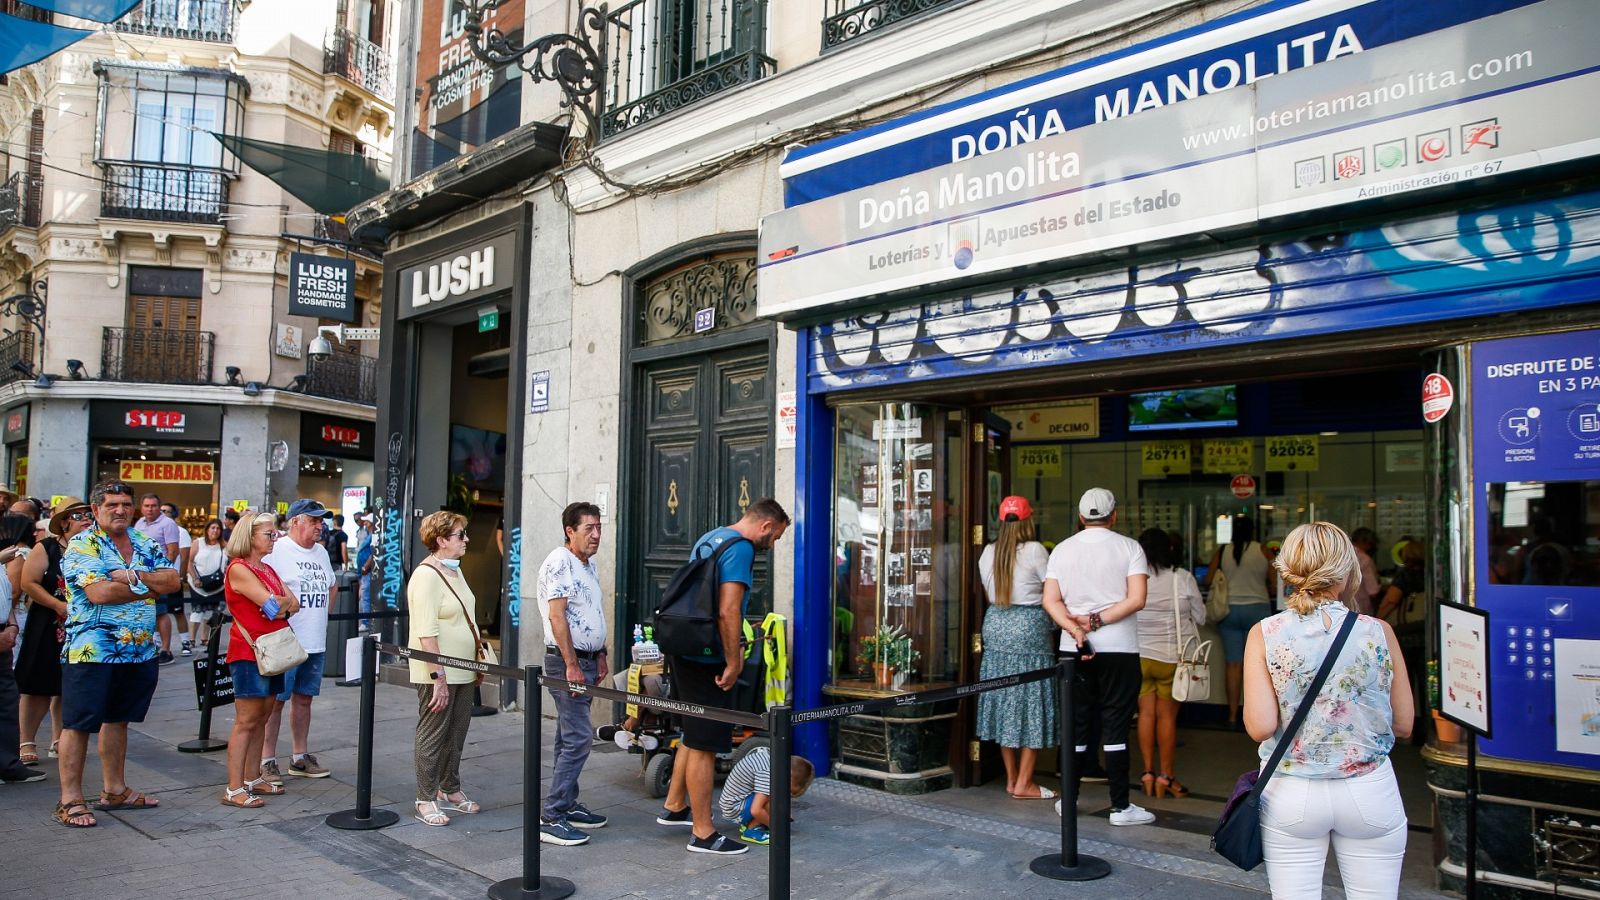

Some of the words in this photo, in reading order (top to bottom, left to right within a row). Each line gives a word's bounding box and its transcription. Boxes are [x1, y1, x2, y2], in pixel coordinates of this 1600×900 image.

[437, 59, 488, 92] HANDMA
[437, 68, 494, 109] COSMETICS
[952, 107, 1066, 164] DOÑA
[1094, 23, 1364, 124] MANOLITA
[1182, 48, 1533, 151] www.loteriamanolita.com
[1358, 170, 1459, 198] Administración
[1483, 160, 1503, 174] 67
[858, 186, 929, 229] Doña
[938, 151, 1080, 209] Manolita
[869, 243, 930, 270] Loterías
[934, 240, 944, 260] y
[984, 215, 1067, 247] Apuestas
[1074, 203, 1103, 226] del
[1109, 189, 1181, 220] Estado
[298, 263, 347, 281] LUSH
[412, 246, 494, 307] LUSH
[298, 277, 347, 293] FRESH
[298, 289, 347, 302] HANDMADE
[298, 297, 346, 309] COSMETICS
[698, 312, 711, 327] 22
[1487, 359, 1567, 378] DISFRUTE
[1571, 356, 1595, 371] DE
[1425, 378, 1442, 394] +18
[1539, 379, 1561, 393] EN
[1565, 377, 1577, 391] 3
[128, 409, 183, 427] STEP
[1049, 422, 1090, 434] DECIMO
[1145, 450, 1187, 461] 26711
[1269, 446, 1315, 457] 92052
[144, 463, 213, 481] REBAJAS
[791, 704, 864, 723] .LOTERIAMANOLITA.COM
